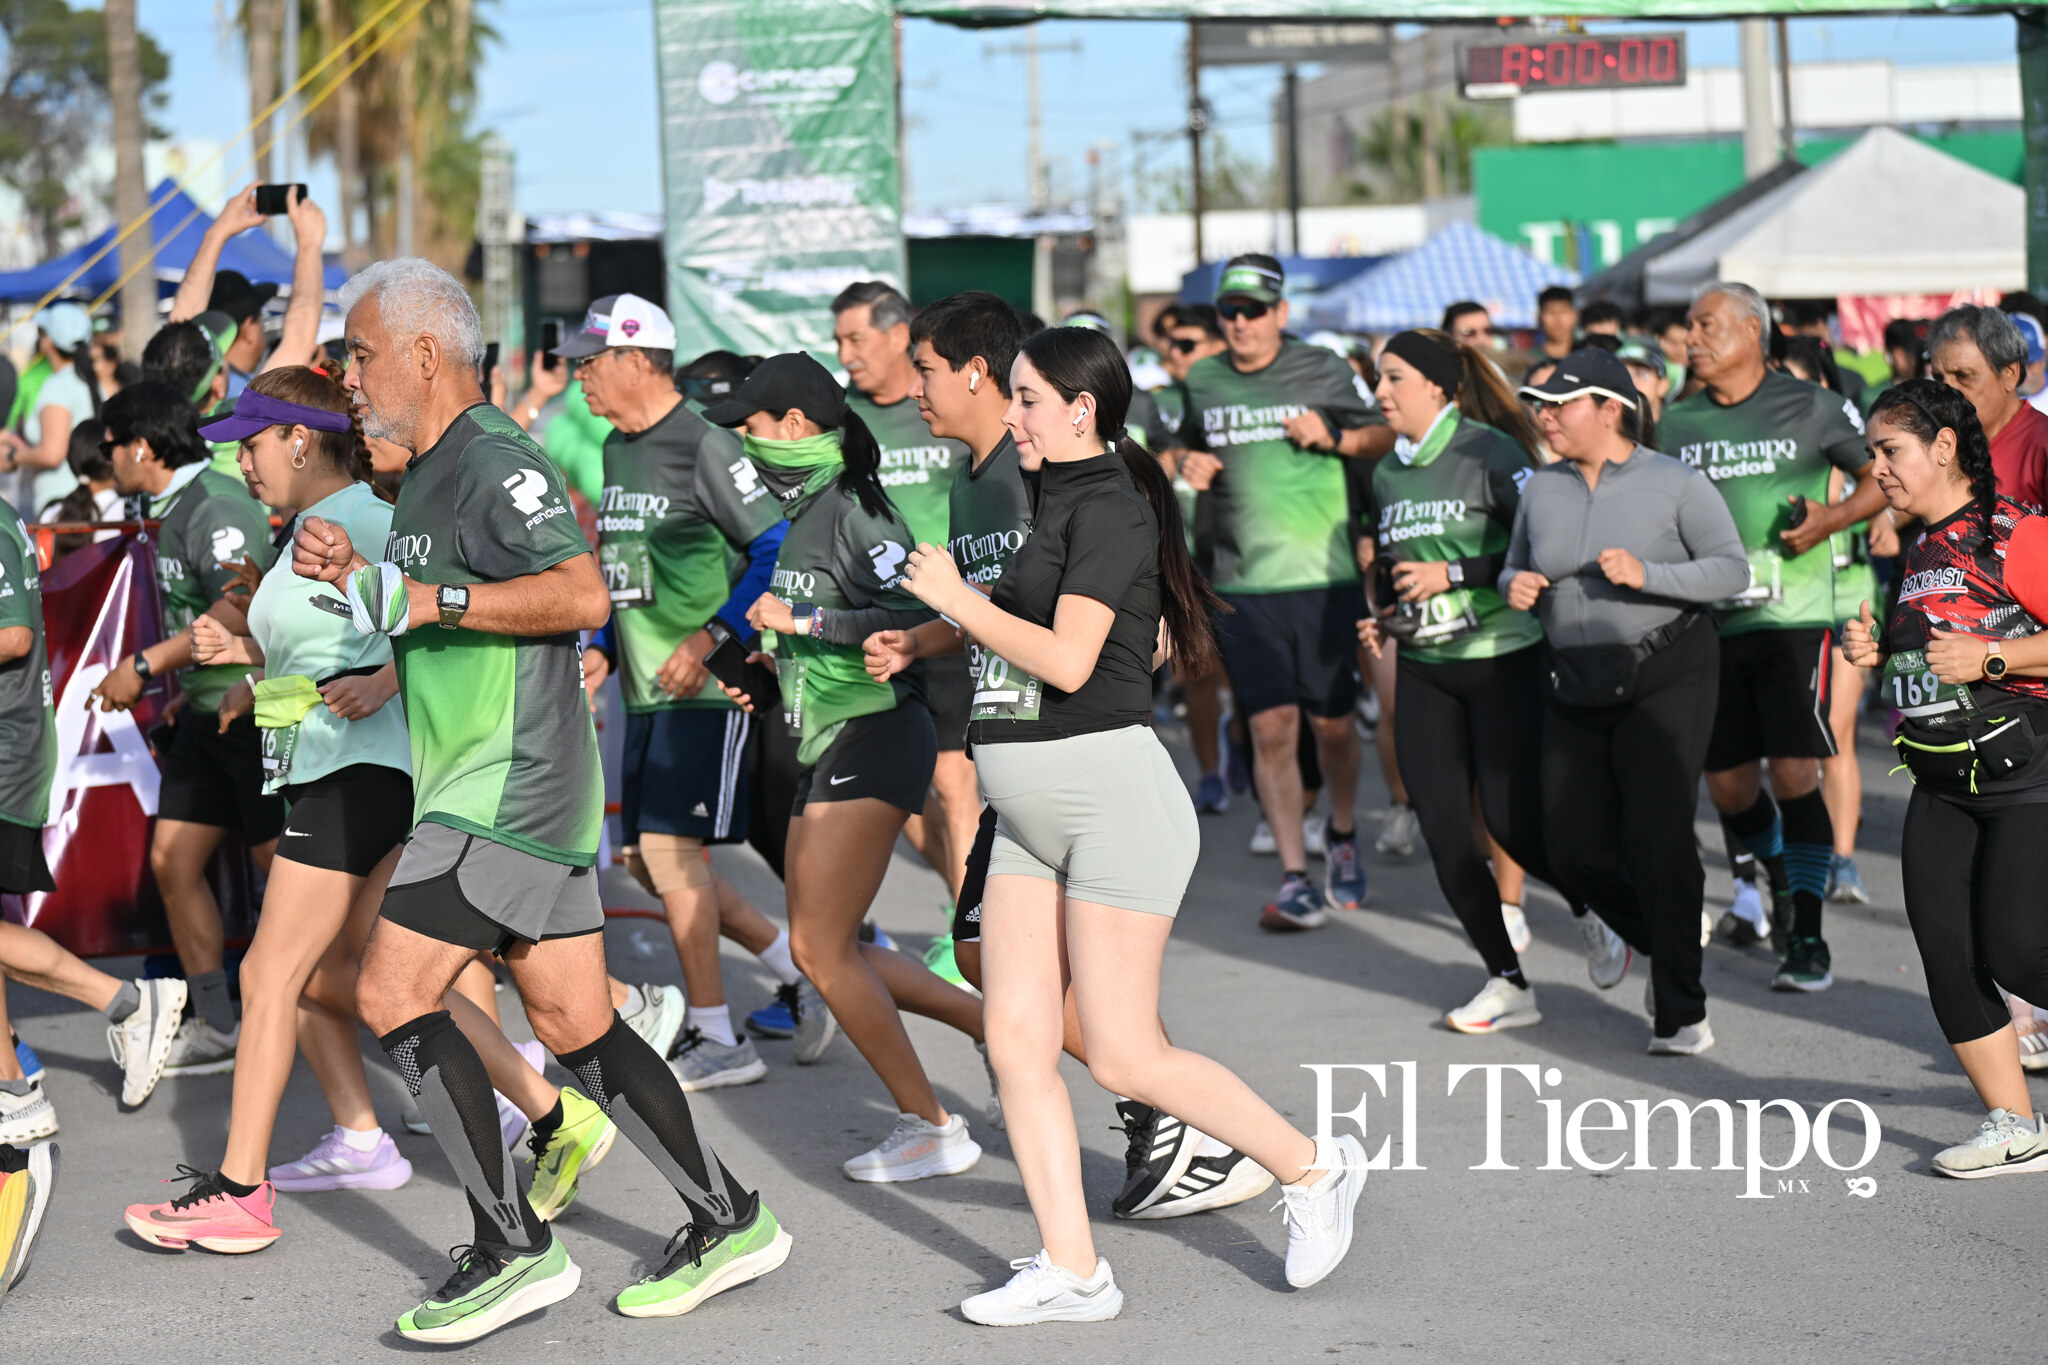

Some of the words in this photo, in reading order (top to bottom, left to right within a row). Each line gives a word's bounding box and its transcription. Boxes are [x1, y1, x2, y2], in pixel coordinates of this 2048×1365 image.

[879, 444, 950, 468] iempo
[1705, 438, 1797, 464] Tiempo
[1708, 459, 1776, 480] todos
[604, 514, 645, 532] todos
[1393, 499, 1466, 523] Tiempo
[1390, 520, 1444, 542] todos
[957, 529, 1023, 565] Tiempo
[1892, 671, 1939, 707] 169
[793, 678, 804, 729] MEDALLA
[900, 1138, 937, 1161] HOKA
